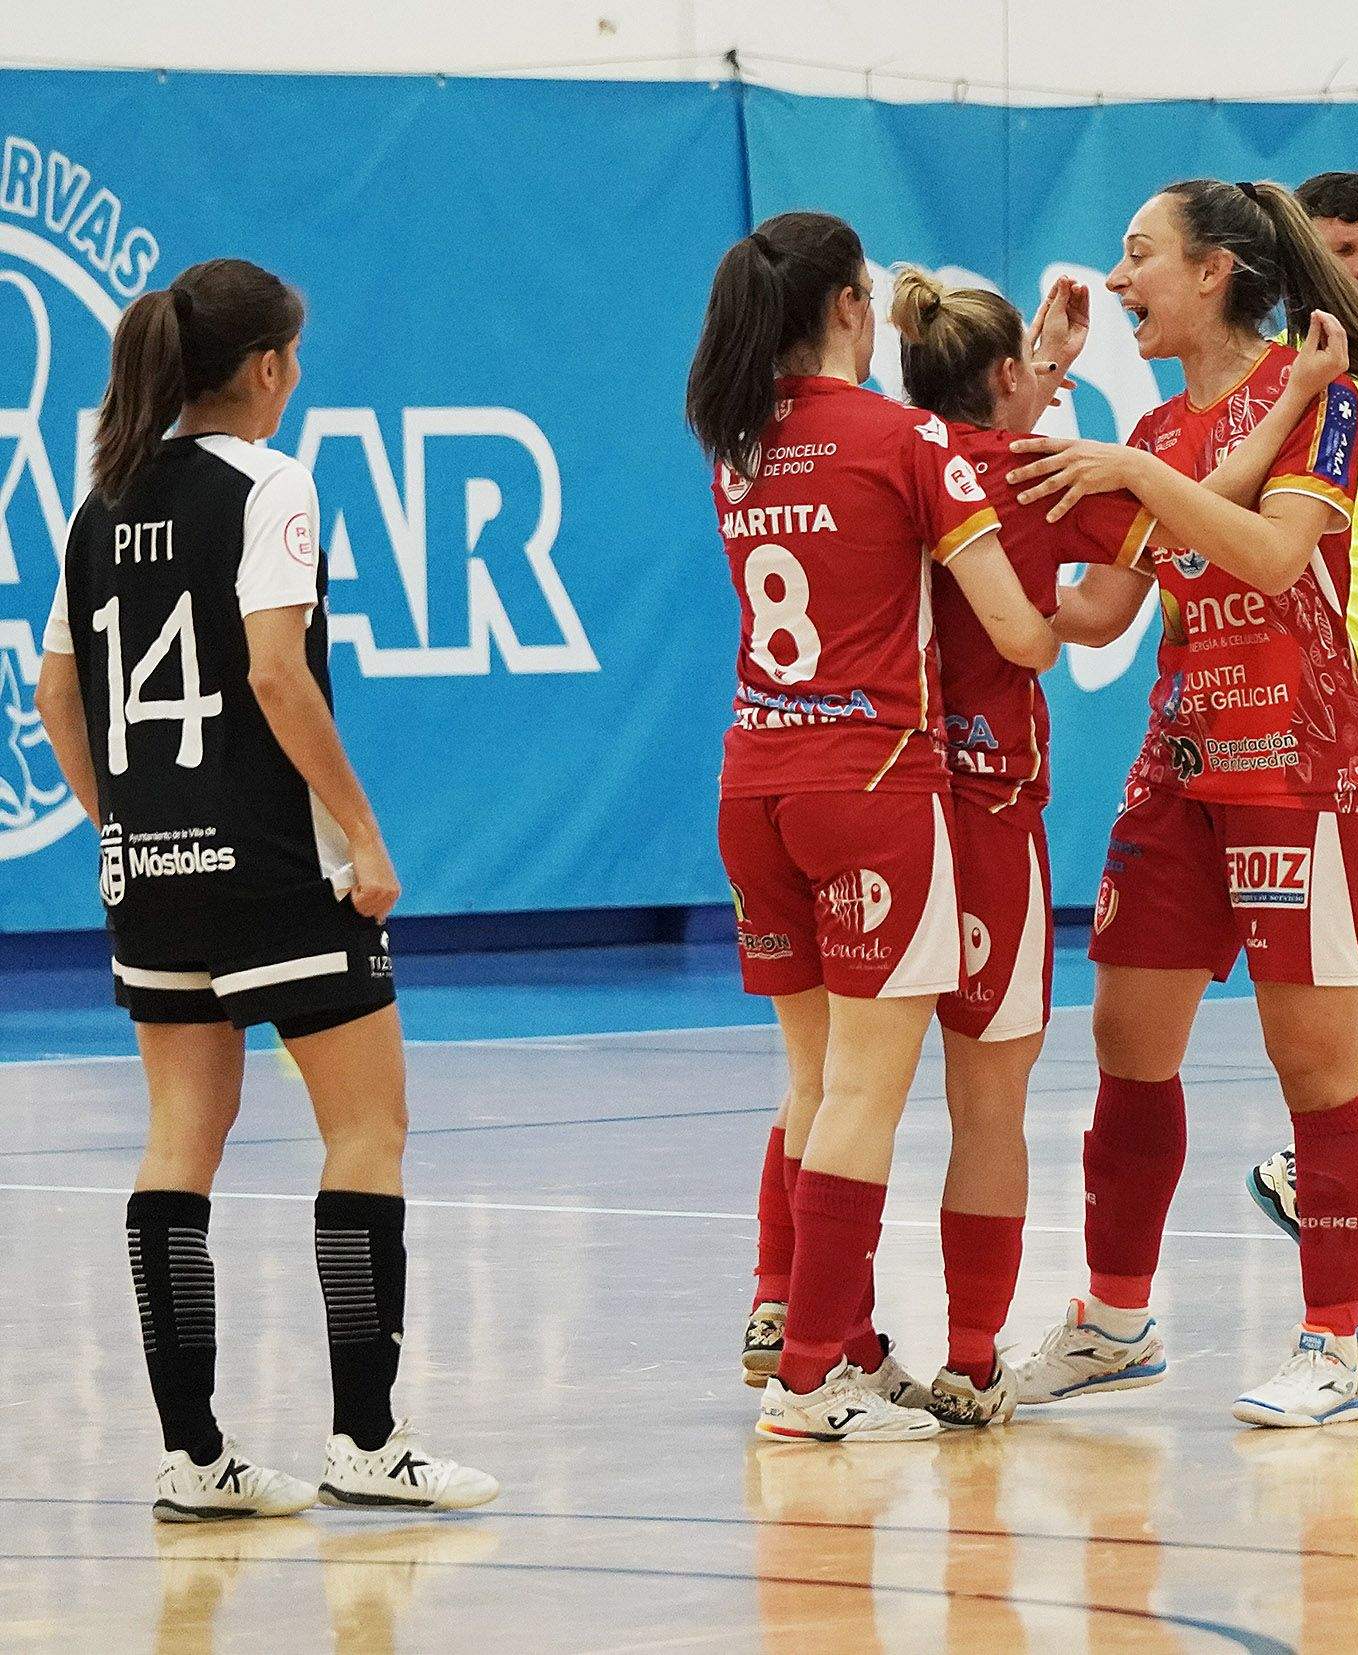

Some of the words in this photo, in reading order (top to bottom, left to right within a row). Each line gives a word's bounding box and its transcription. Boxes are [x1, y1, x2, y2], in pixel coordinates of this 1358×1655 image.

[764, 463, 780, 477] DE
[782, 460, 815, 475] POIO
[766, 442, 837, 460] CONCELLO
[114, 519, 175, 565] PITI
[744, 543, 822, 686] 8
[92, 590, 223, 776] 14
[1180, 696, 1207, 715] DE
[1211, 683, 1290, 711] GALICIA
[1206, 728, 1299, 757] Deputación
[1210, 752, 1299, 773] Pontevedra
[128, 841, 237, 879] Móstoles
[1226, 851, 1307, 889] FROIZ
